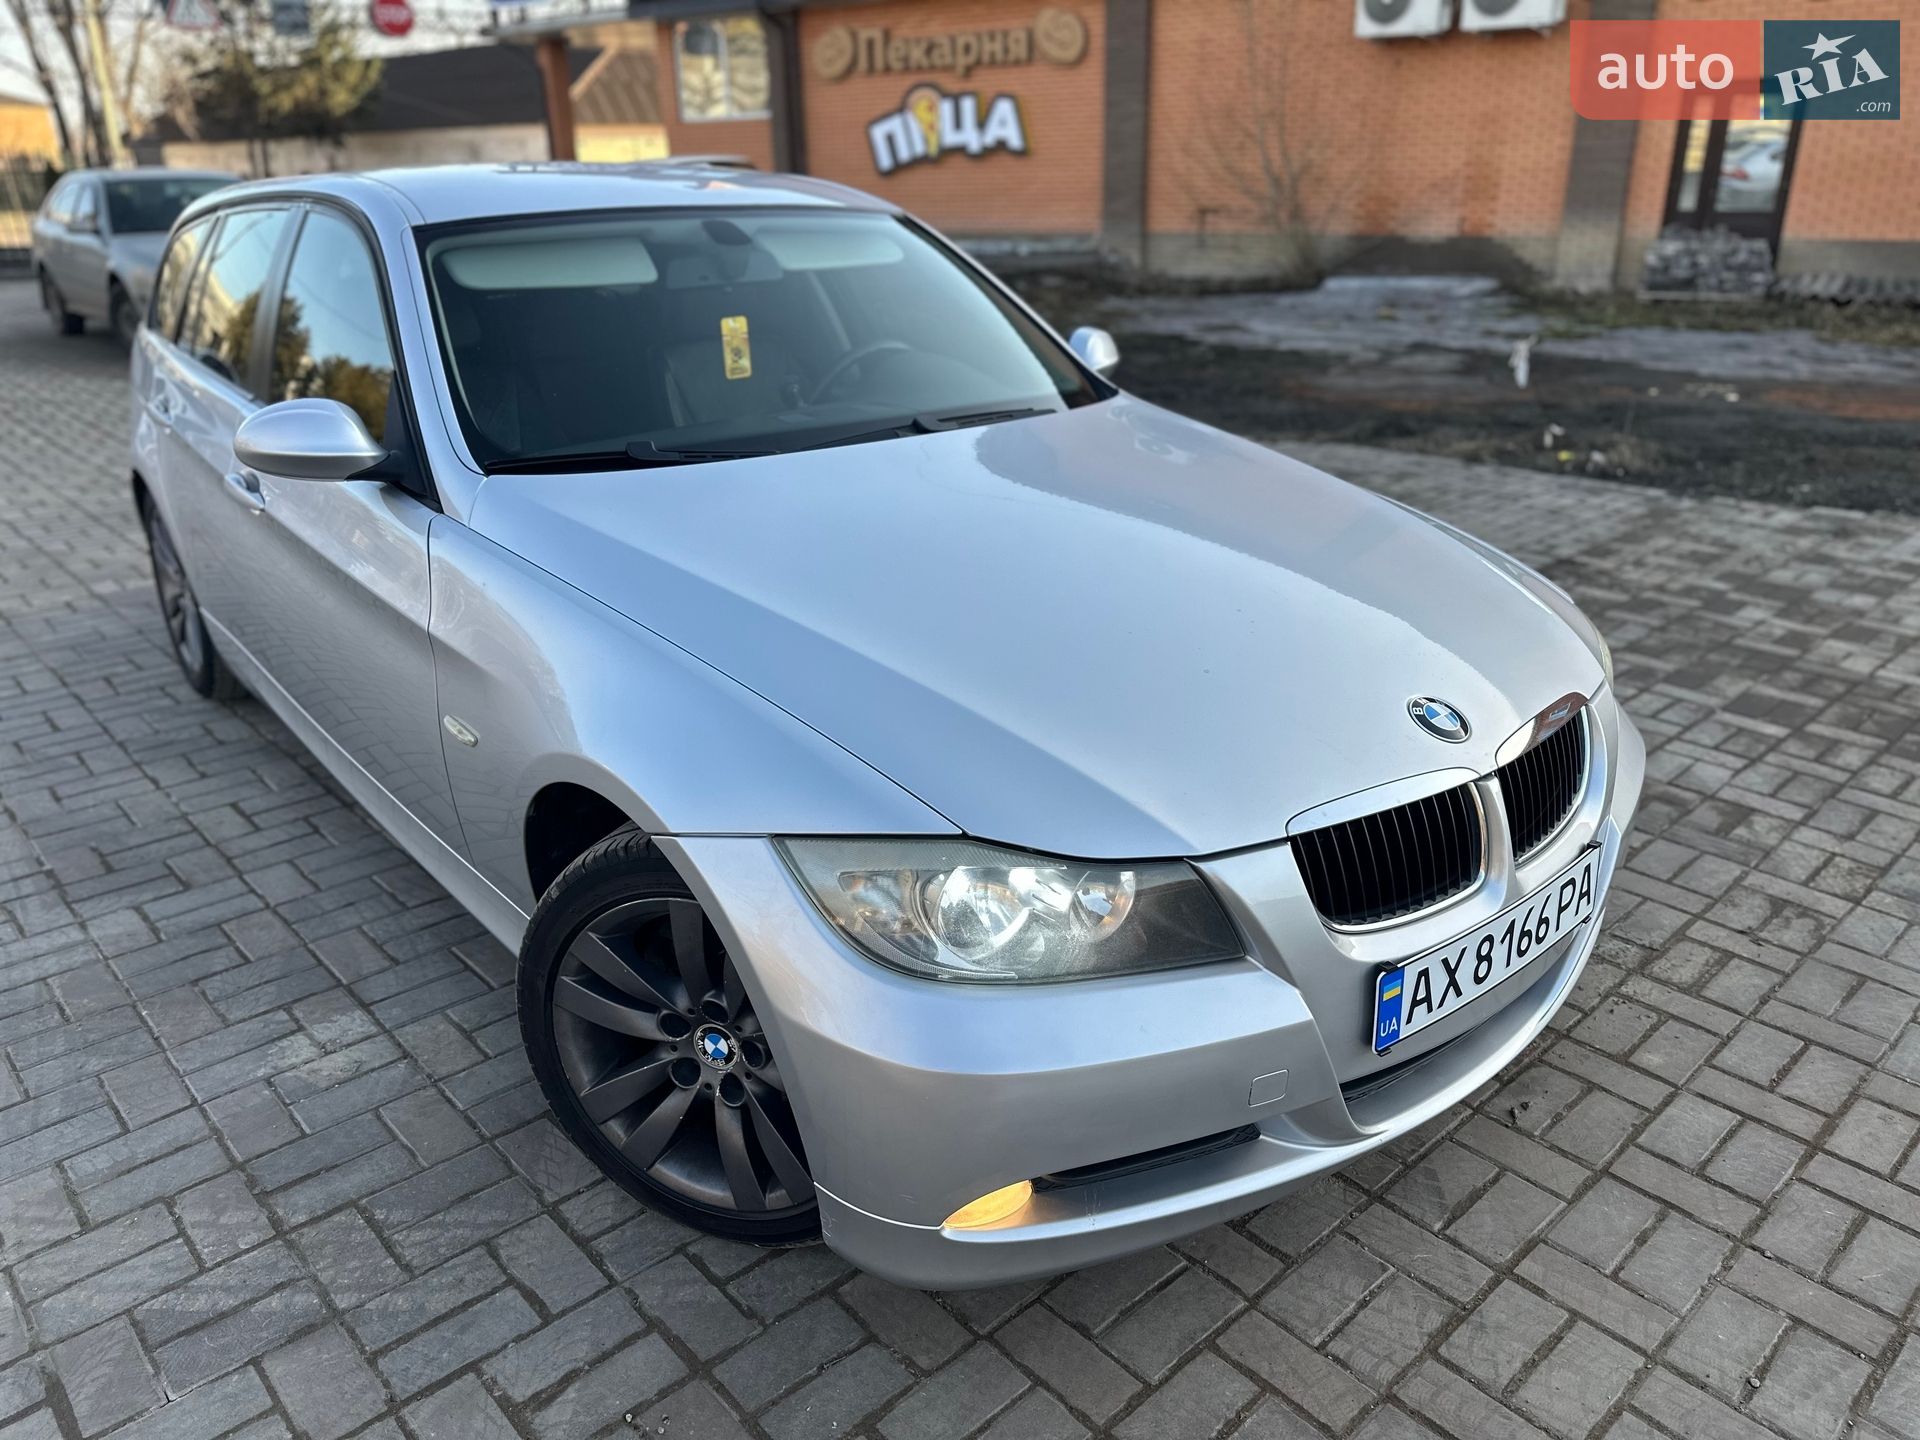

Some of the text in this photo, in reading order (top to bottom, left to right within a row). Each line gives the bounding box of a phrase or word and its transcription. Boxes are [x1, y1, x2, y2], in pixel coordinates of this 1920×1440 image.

[857, 28, 1031, 76] Пекарня
[867, 92, 1027, 173] ПІЦА
[1380, 1016, 1398, 1037] UA
